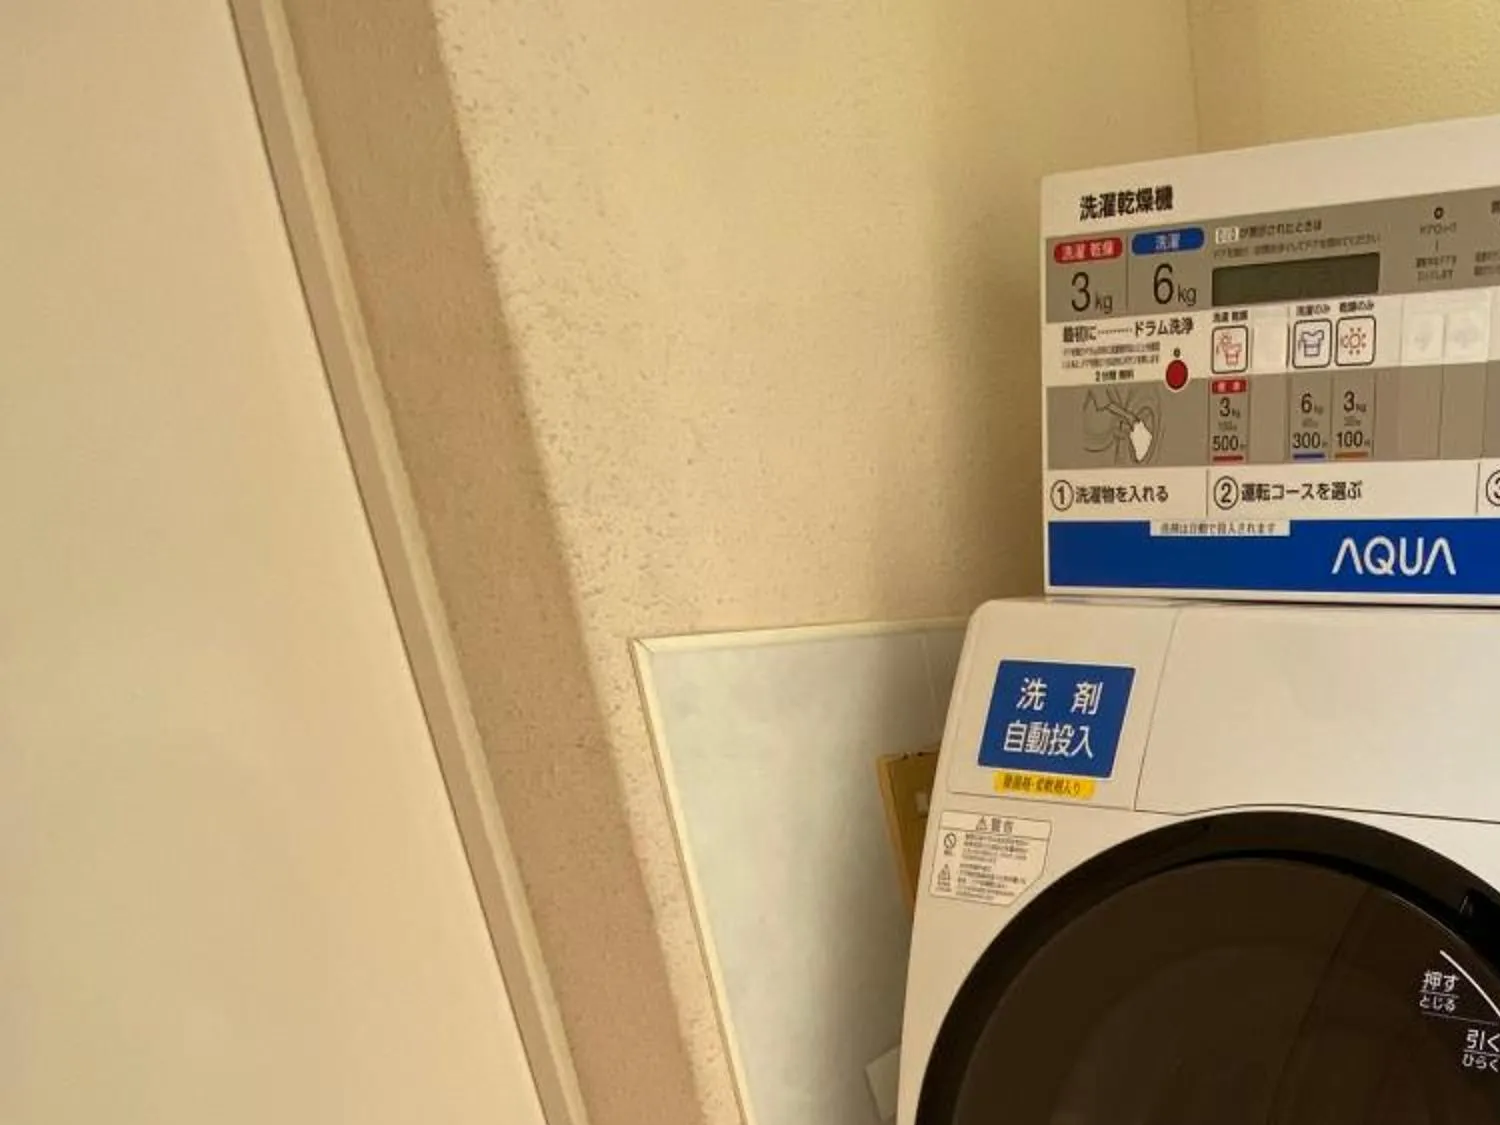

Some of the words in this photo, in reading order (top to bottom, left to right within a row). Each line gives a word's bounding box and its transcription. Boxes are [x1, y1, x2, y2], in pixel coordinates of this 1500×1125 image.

[1080, 185, 1174, 220] 洗濯乾燥機
[1331, 535, 1457, 576] AQUA
[1003, 720, 1093, 759] 自動投入
[1421, 970, 1460, 992] 押す
[1419, 995, 1456, 1012] とじる
[1467, 1029, 1500, 1052] 引く
[1462, 1053, 1500, 1073] ひらく
